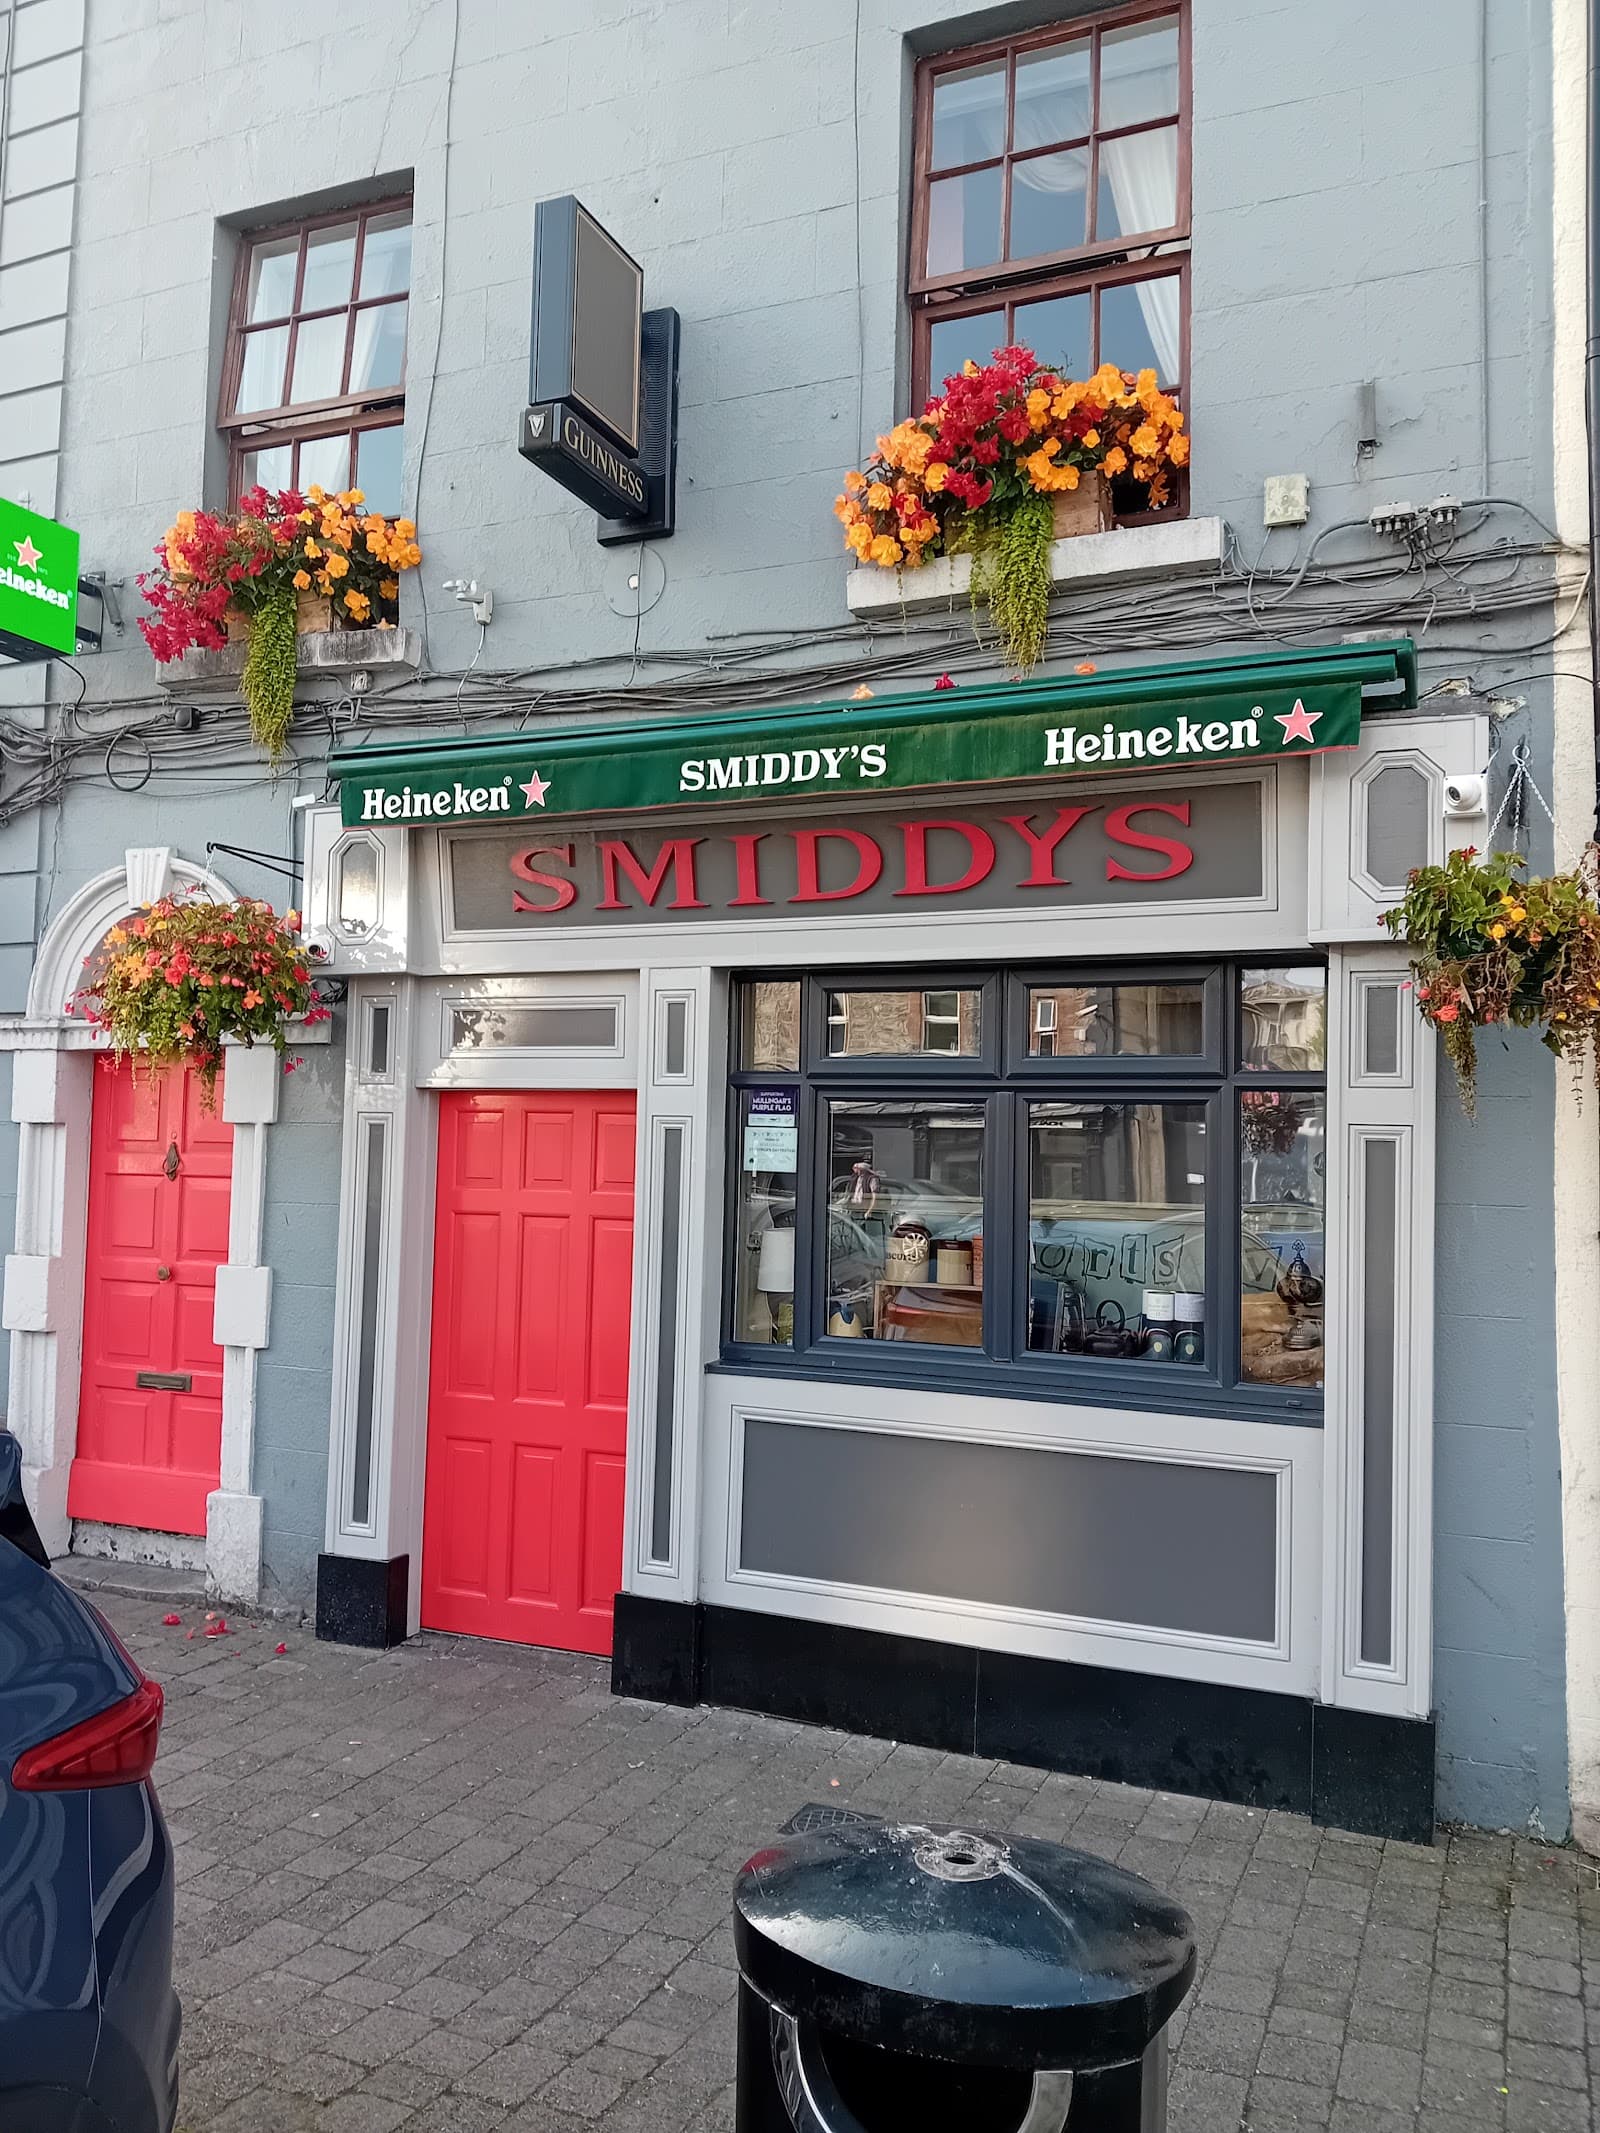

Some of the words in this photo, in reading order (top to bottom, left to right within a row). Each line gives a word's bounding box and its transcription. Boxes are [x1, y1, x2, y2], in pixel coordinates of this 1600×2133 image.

[563, 415, 644, 503] GUINNESS
[0, 566, 70, 610] eineken
[679, 744, 887, 792] SMIDDY'S
[508, 801, 1195, 914] SMIDDYS
